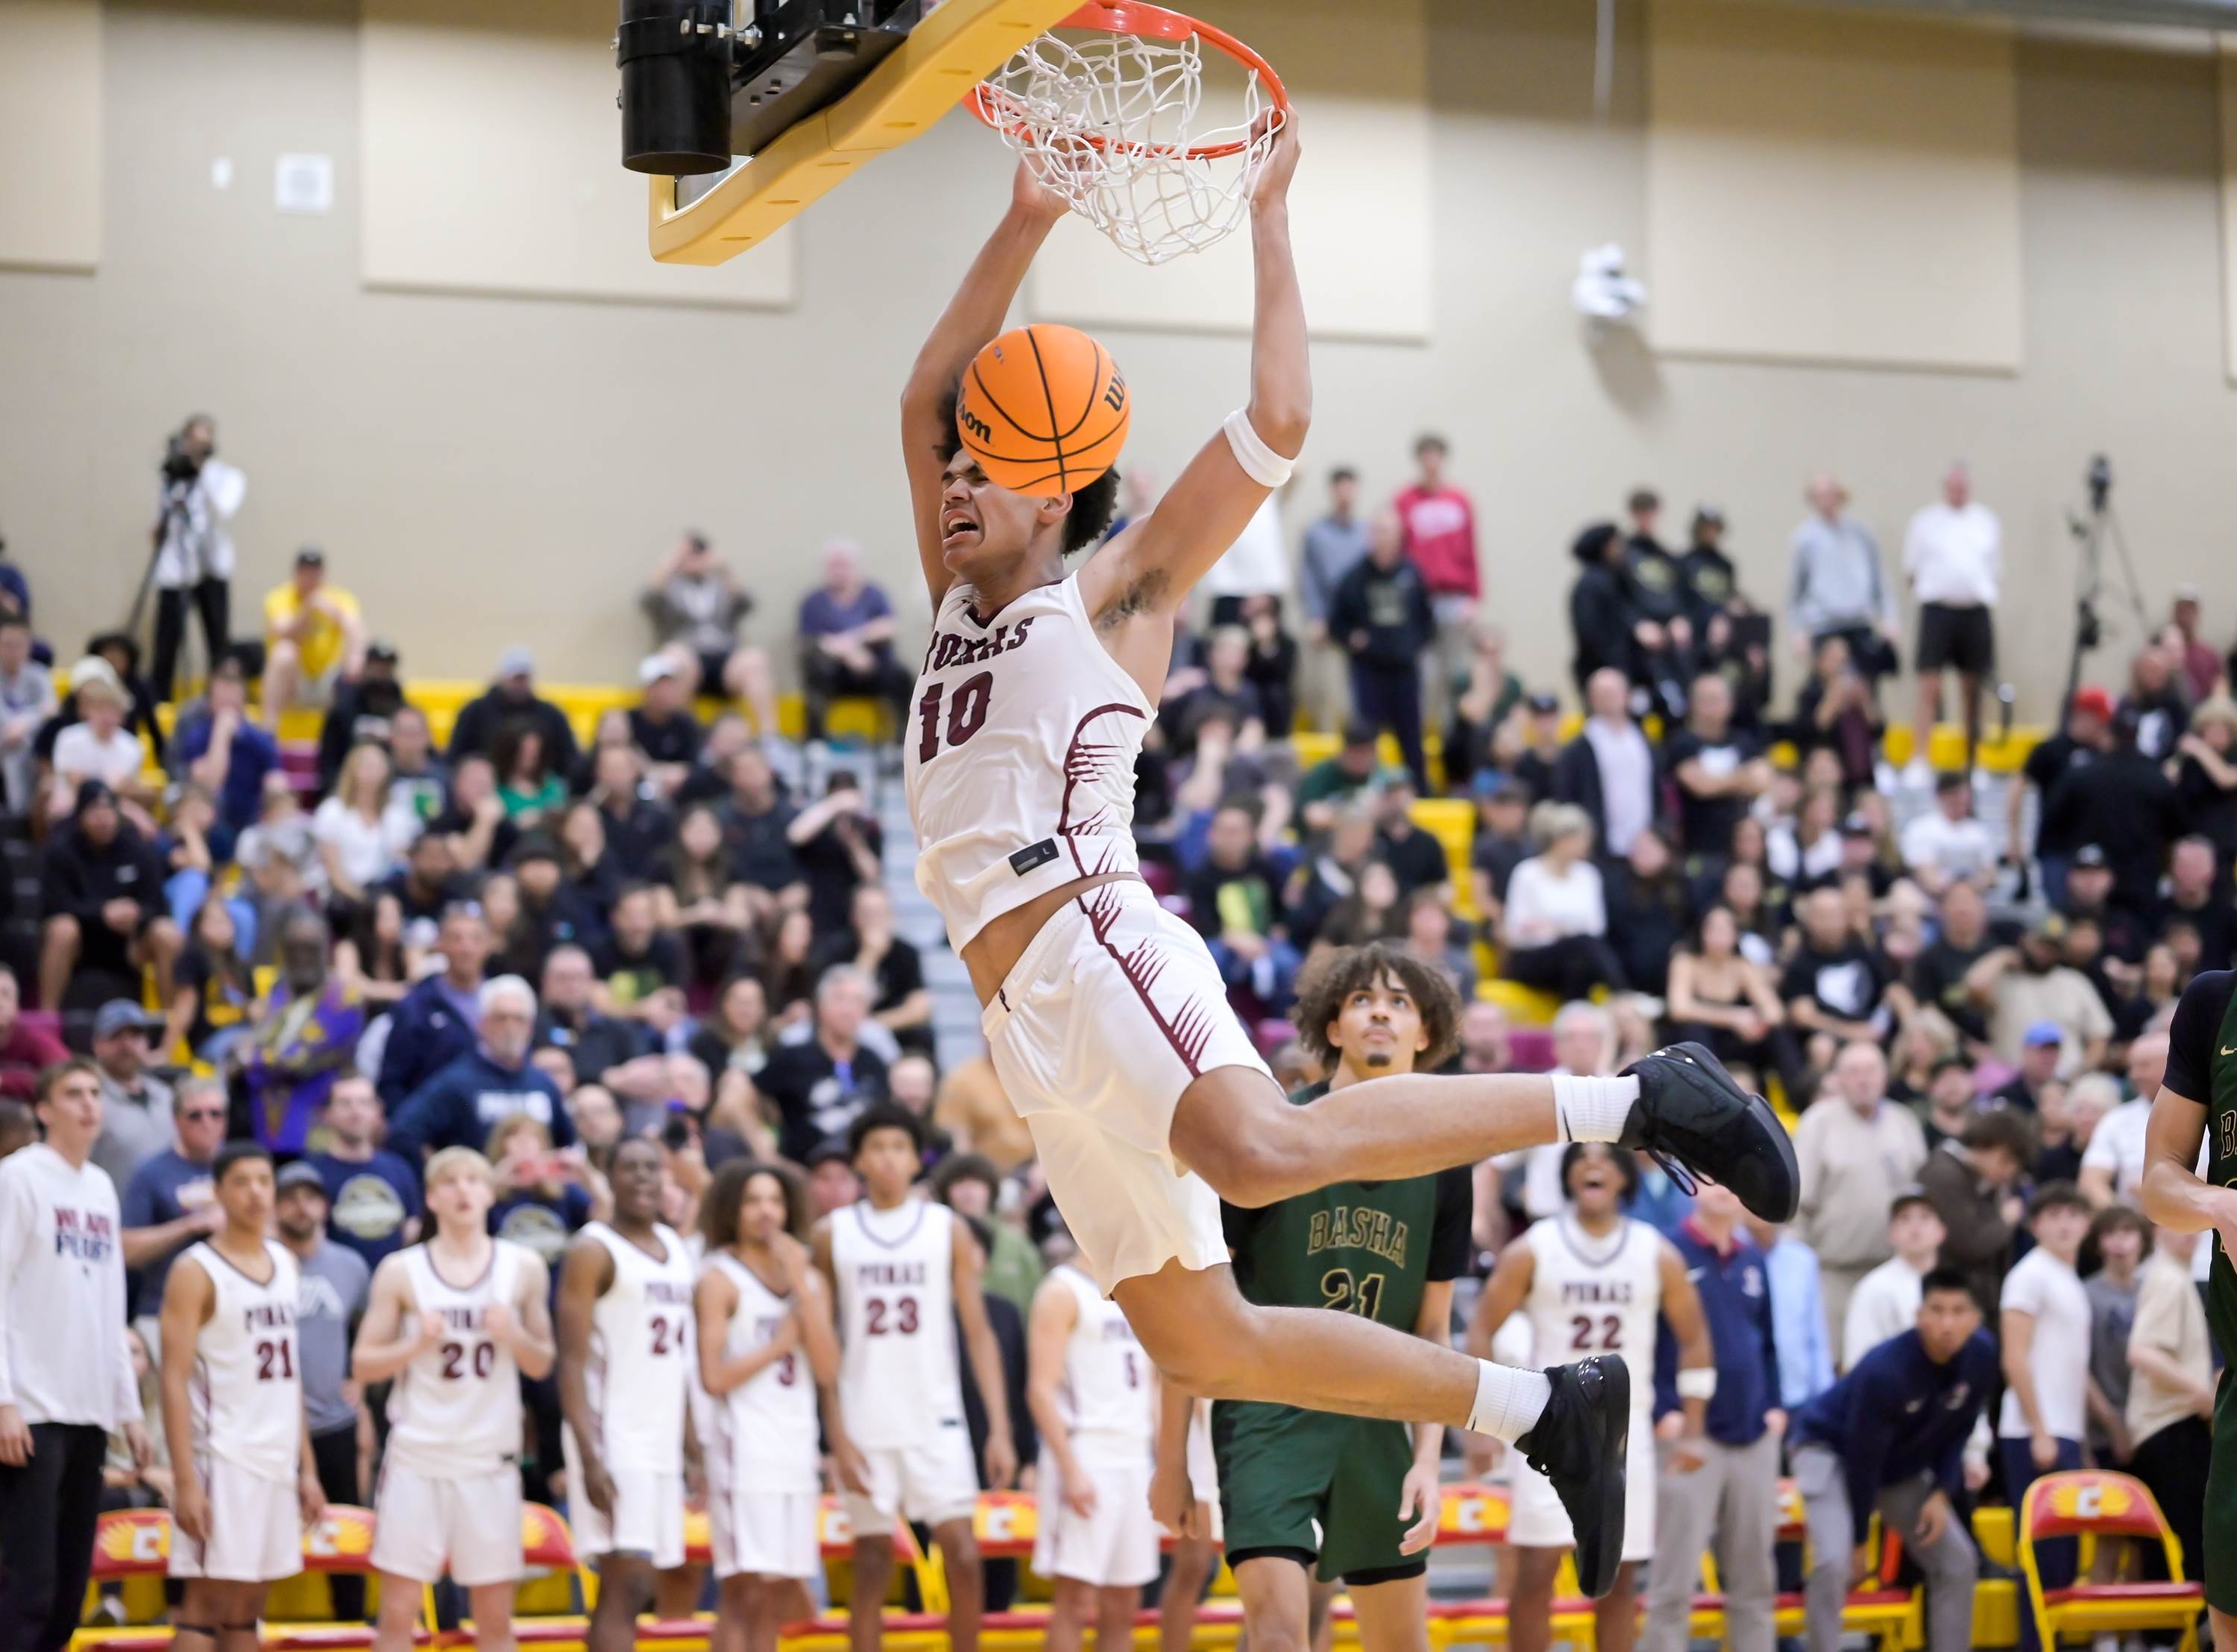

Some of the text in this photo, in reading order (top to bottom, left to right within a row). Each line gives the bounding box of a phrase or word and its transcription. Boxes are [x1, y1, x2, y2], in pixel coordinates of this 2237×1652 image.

[922, 616, 1036, 675] UMAS
[919, 671, 993, 765] 10
[1306, 1205, 1409, 1270] BASHA
[866, 1297, 919, 1336] 23
[1321, 1267, 1385, 1321] 21
[1571, 1314, 1623, 1350] 22
[257, 1338, 293, 1379] 21
[441, 1341, 494, 1381] 20
